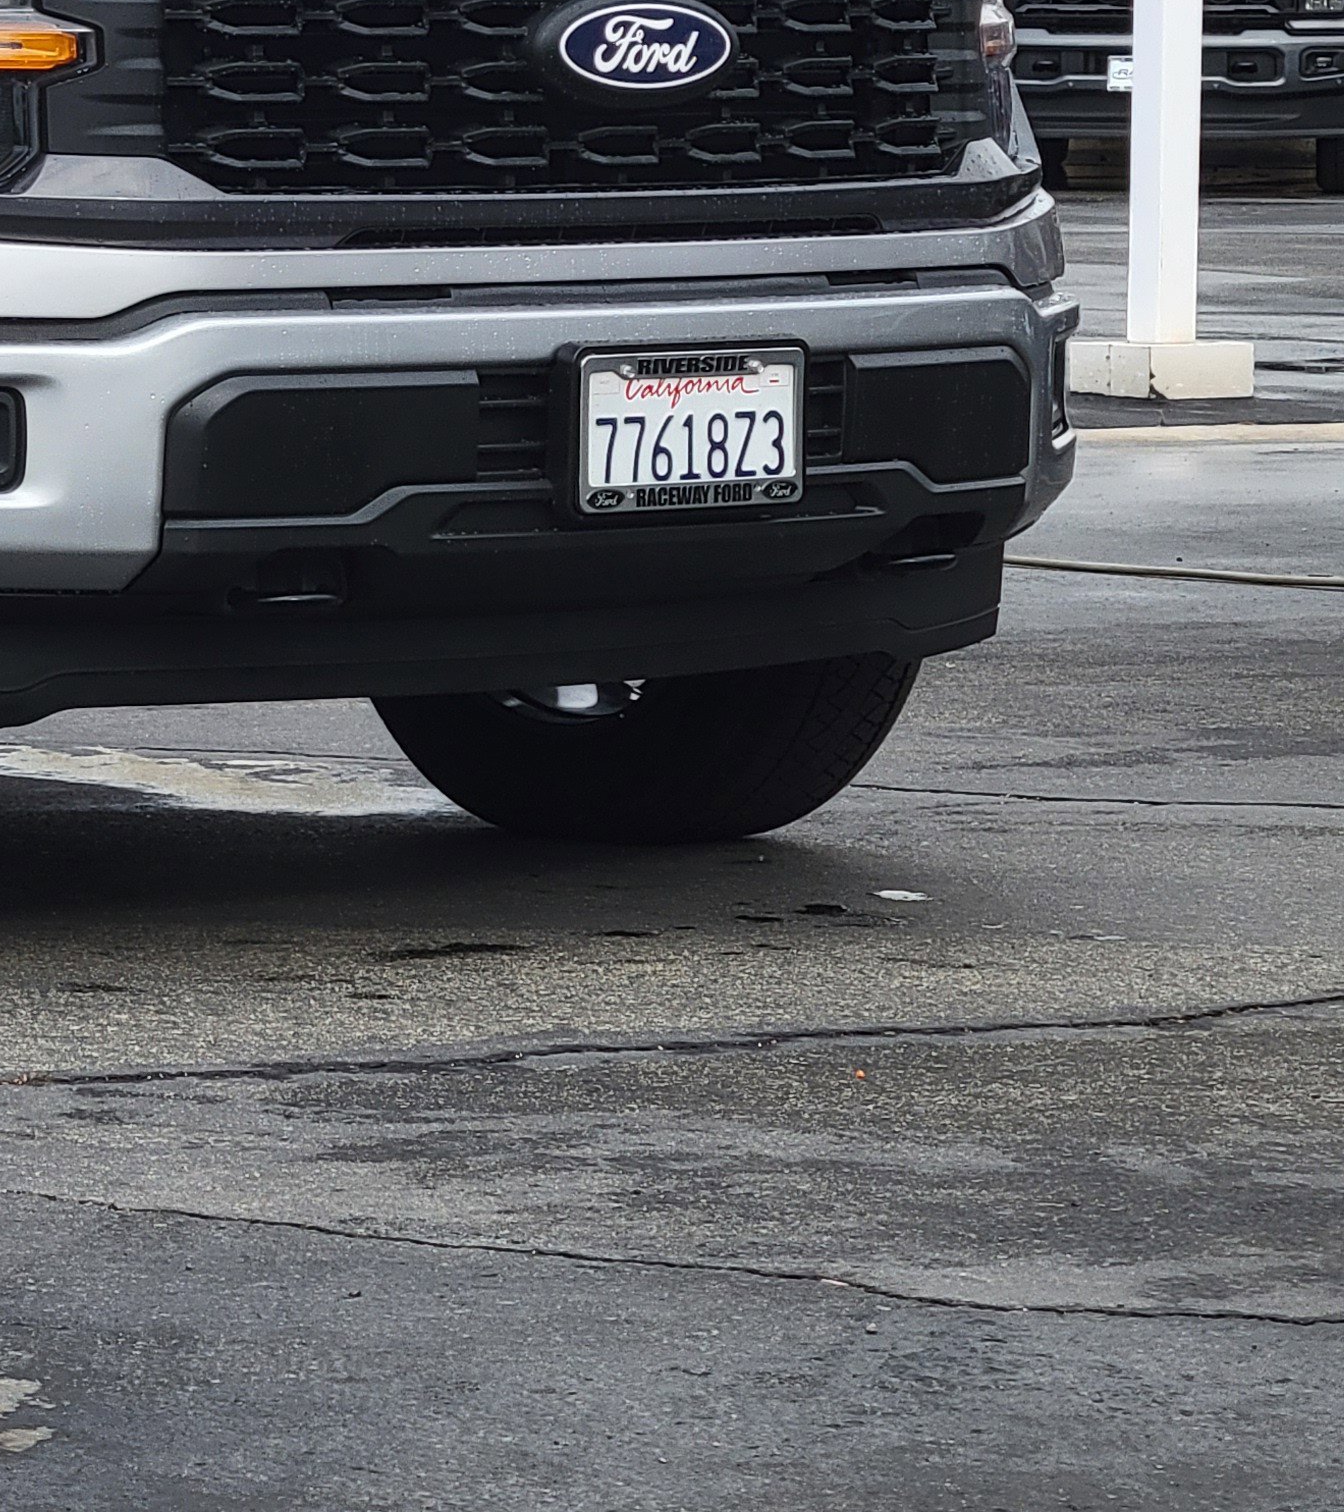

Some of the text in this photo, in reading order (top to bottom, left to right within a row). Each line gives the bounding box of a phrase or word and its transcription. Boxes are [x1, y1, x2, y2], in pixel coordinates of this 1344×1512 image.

[593, 15, 699, 73] Ford
[637, 355, 749, 376] RIVERSIDE
[625, 376, 759, 409] California
[595, 410, 785, 484] 77618Z3
[594, 492, 619, 507] Ford
[636, 483, 753, 507] RACEWAY FORD
